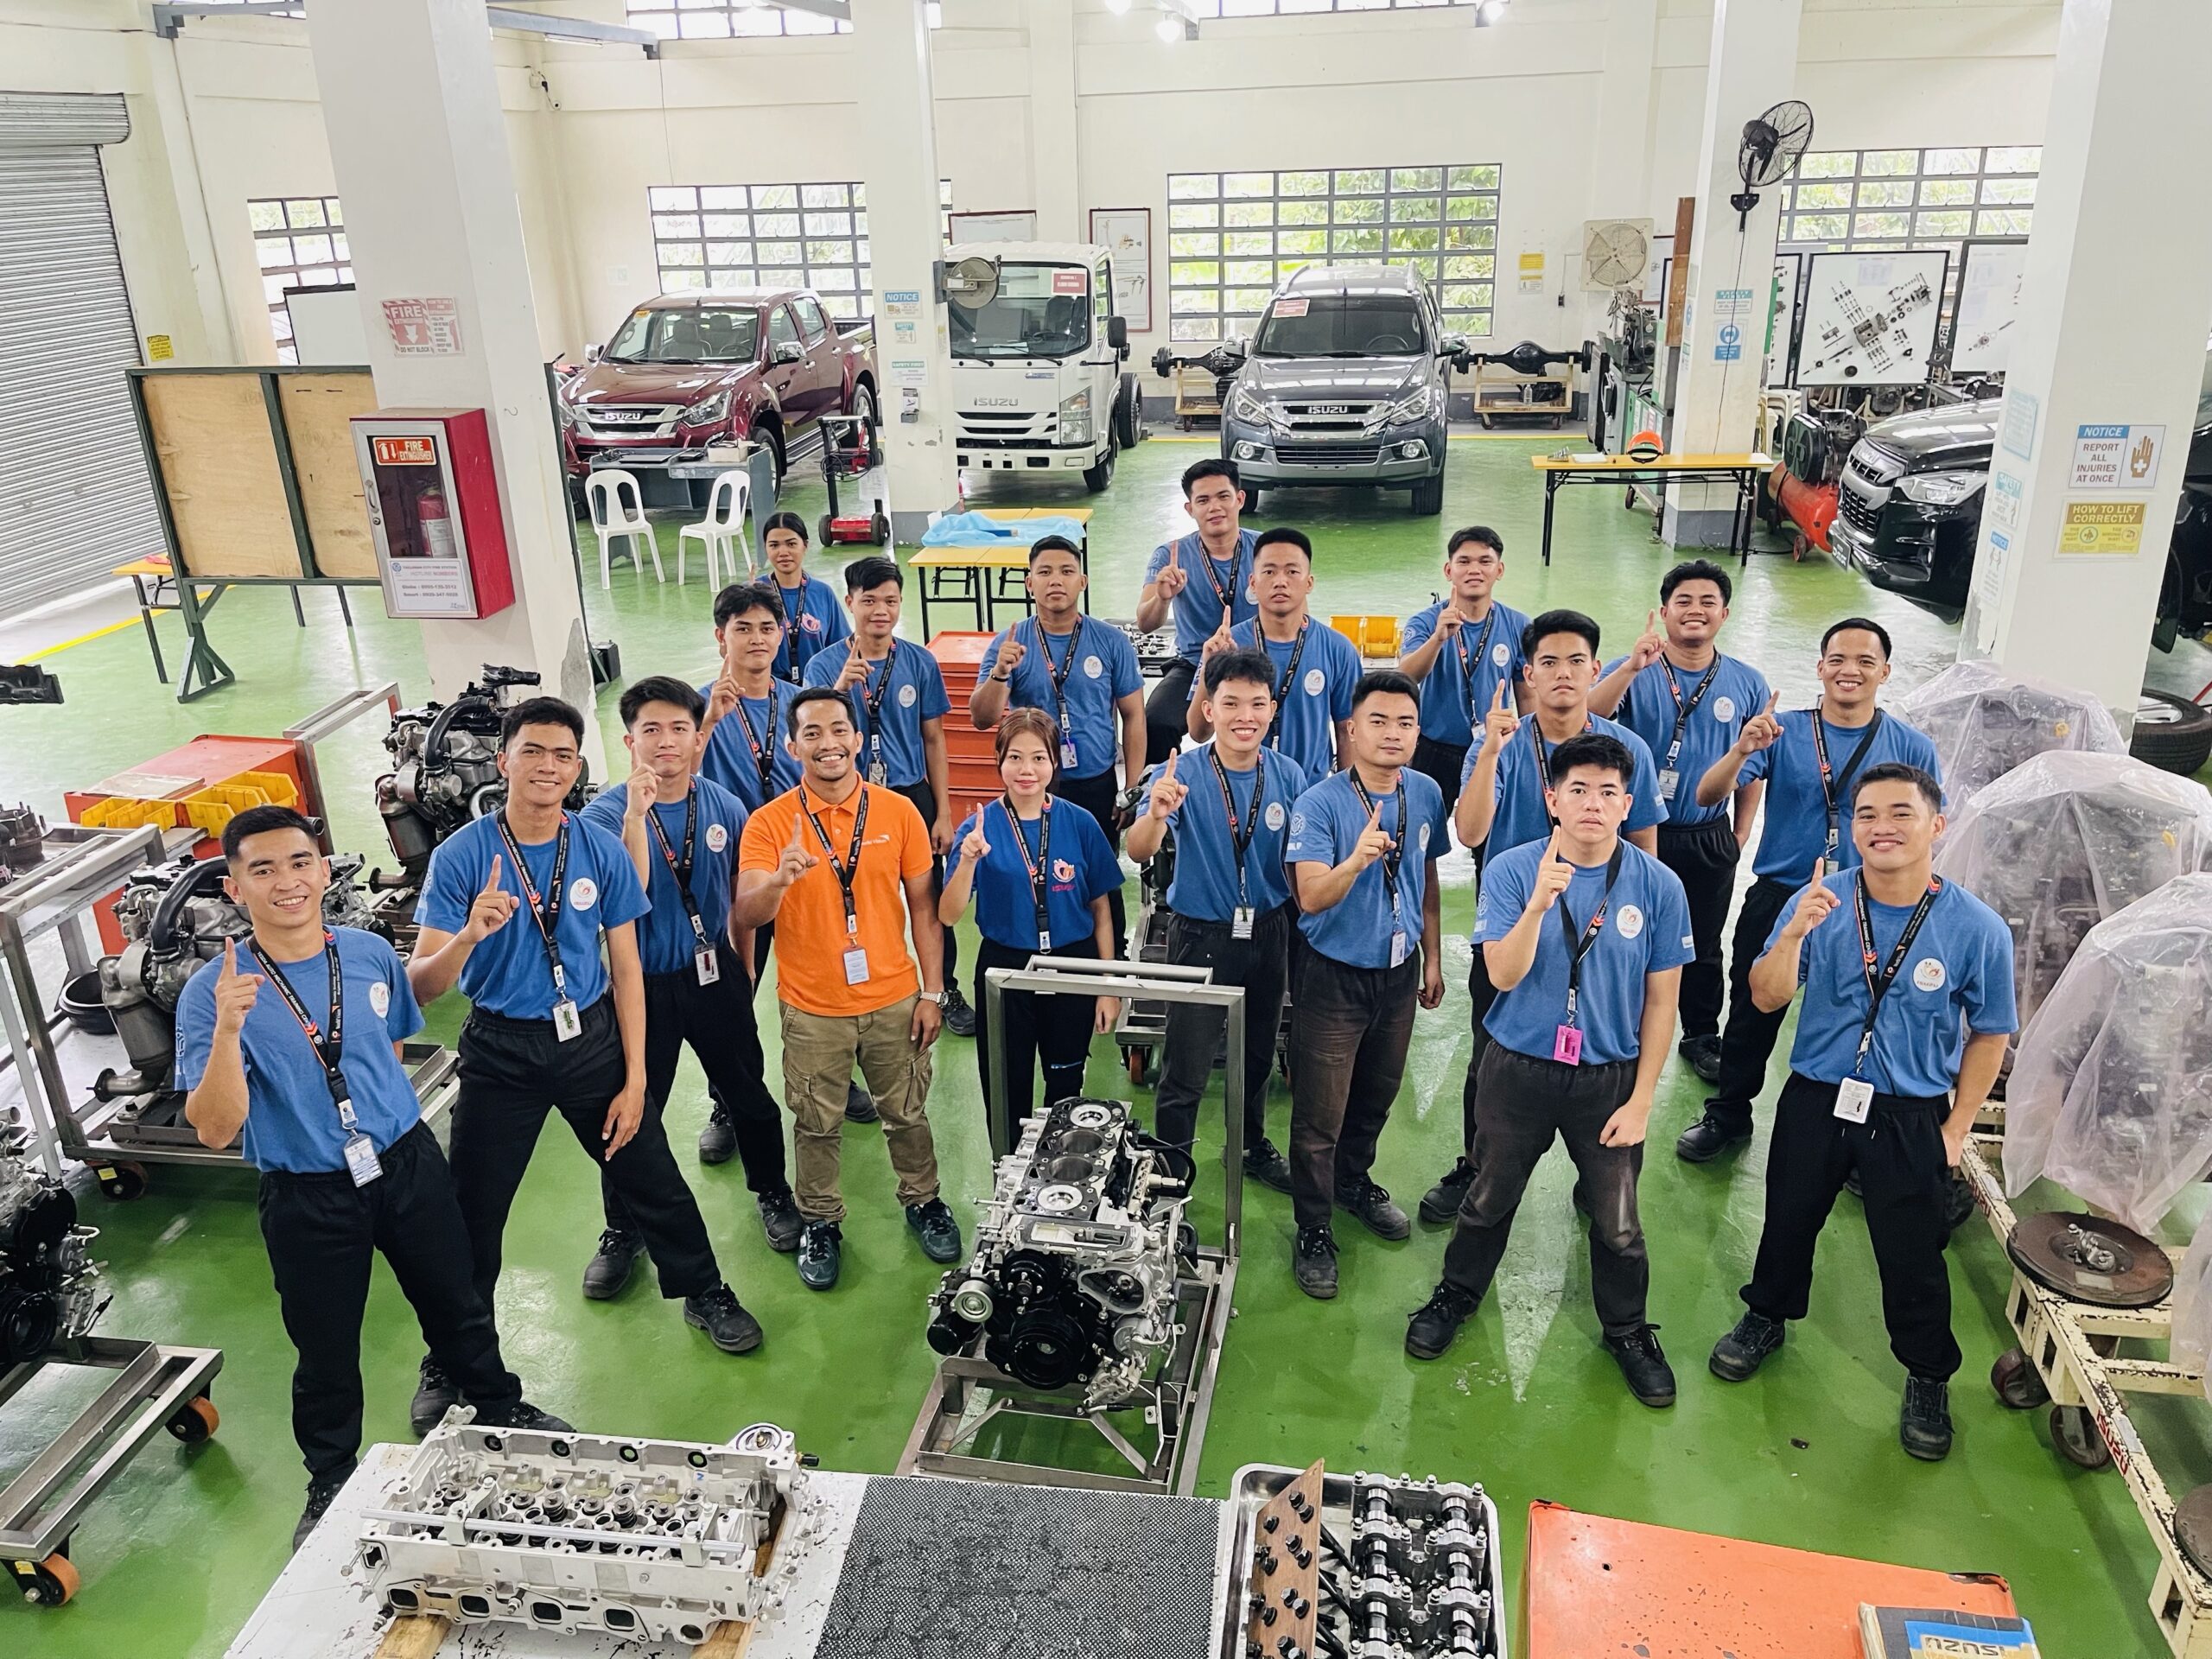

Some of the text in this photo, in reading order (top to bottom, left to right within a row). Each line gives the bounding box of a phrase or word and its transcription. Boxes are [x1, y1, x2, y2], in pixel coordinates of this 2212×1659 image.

[391, 305, 423, 318] FIRE
[974, 397, 1019, 406] ISUZU
[2083, 427, 2124, 436] NOTICE
[404, 441, 423, 450] FIRE
[2073, 505, 2140, 513] HOW TO LIFT
[2074, 514, 2136, 523] CORRECTLY
[274, 974, 291, 996] MECHANIC
[289, 995, 304, 1015] TRAINING
[2097, 1408, 2129, 1476] ISUZU
[1925, 1637, 2005, 1657] ISUZU
